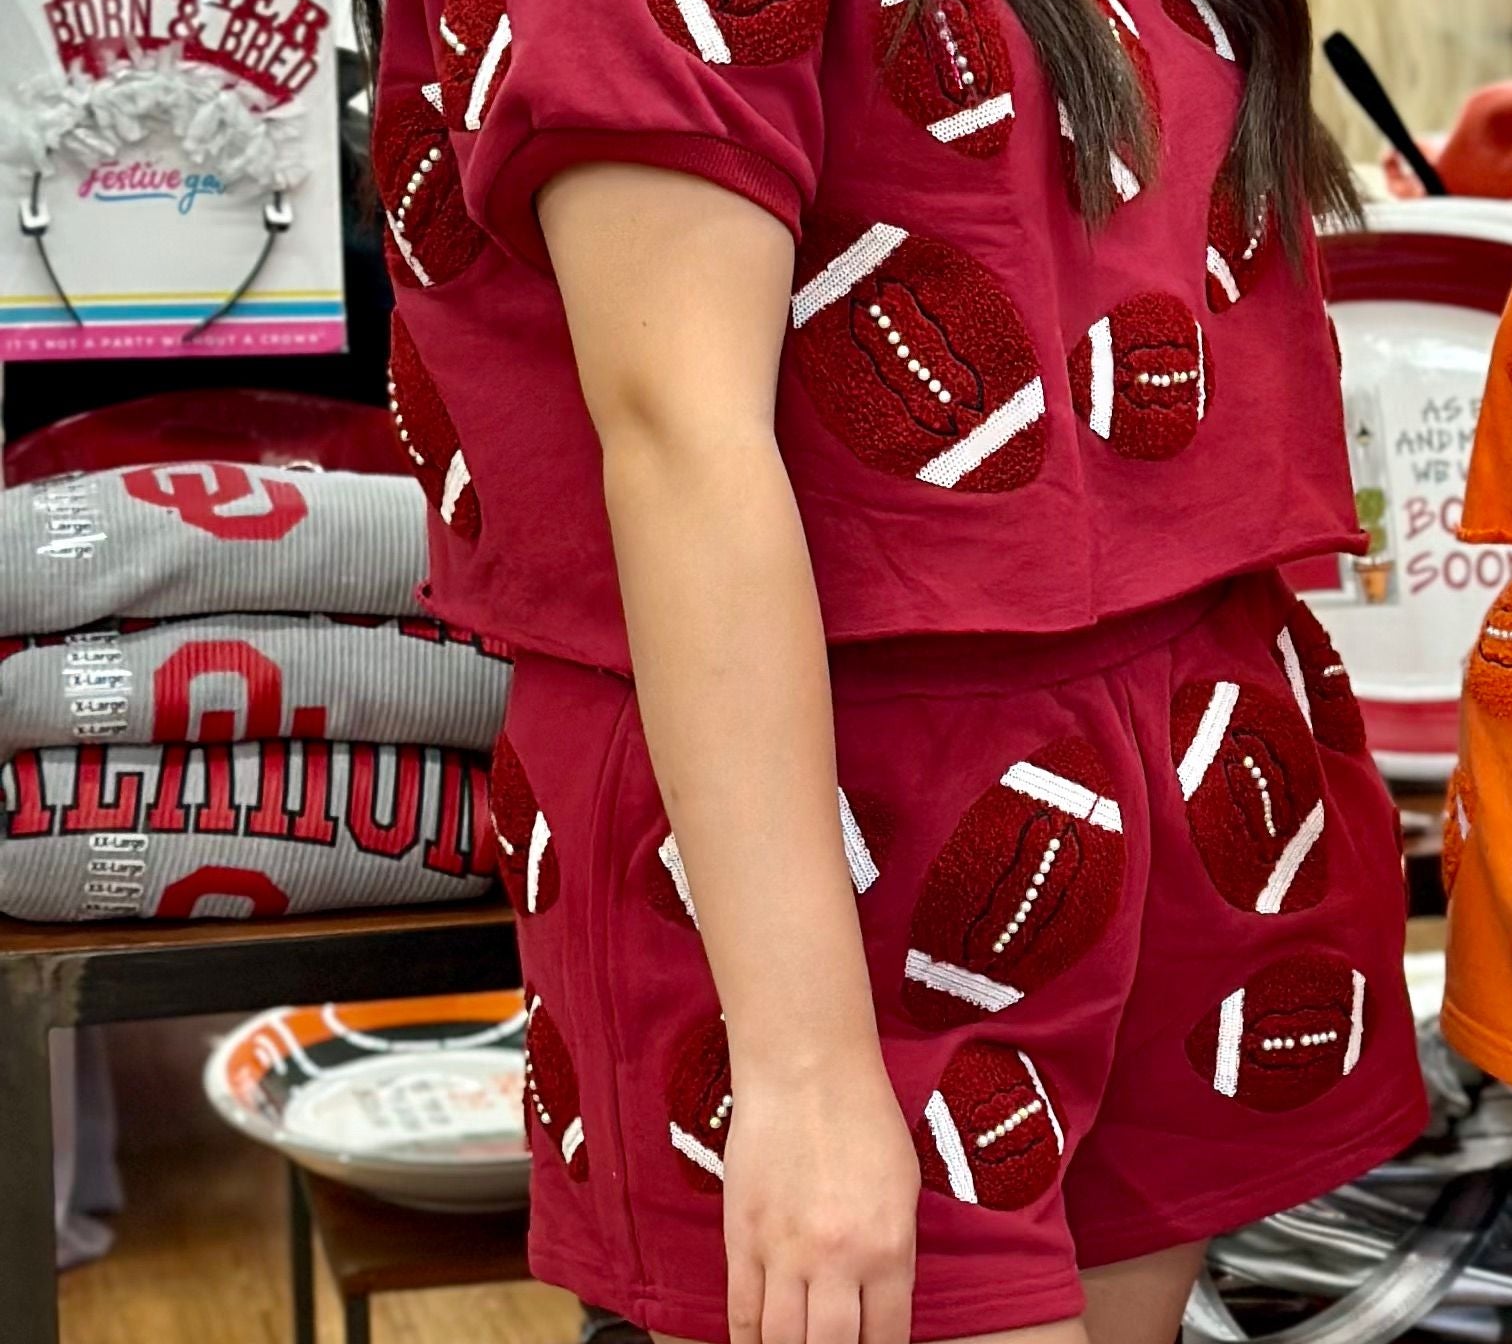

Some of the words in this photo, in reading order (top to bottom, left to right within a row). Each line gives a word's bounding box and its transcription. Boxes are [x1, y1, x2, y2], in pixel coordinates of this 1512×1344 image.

[221, 22, 322, 94] BRED
[47, 338, 77, 350] NOT
[101, 336, 154, 348] PARTY
[260, 332, 319, 346] CROWN
[1421, 397, 1463, 423] AS
[1395, 428, 1452, 454] AND
[1411, 460, 1449, 485] WE
